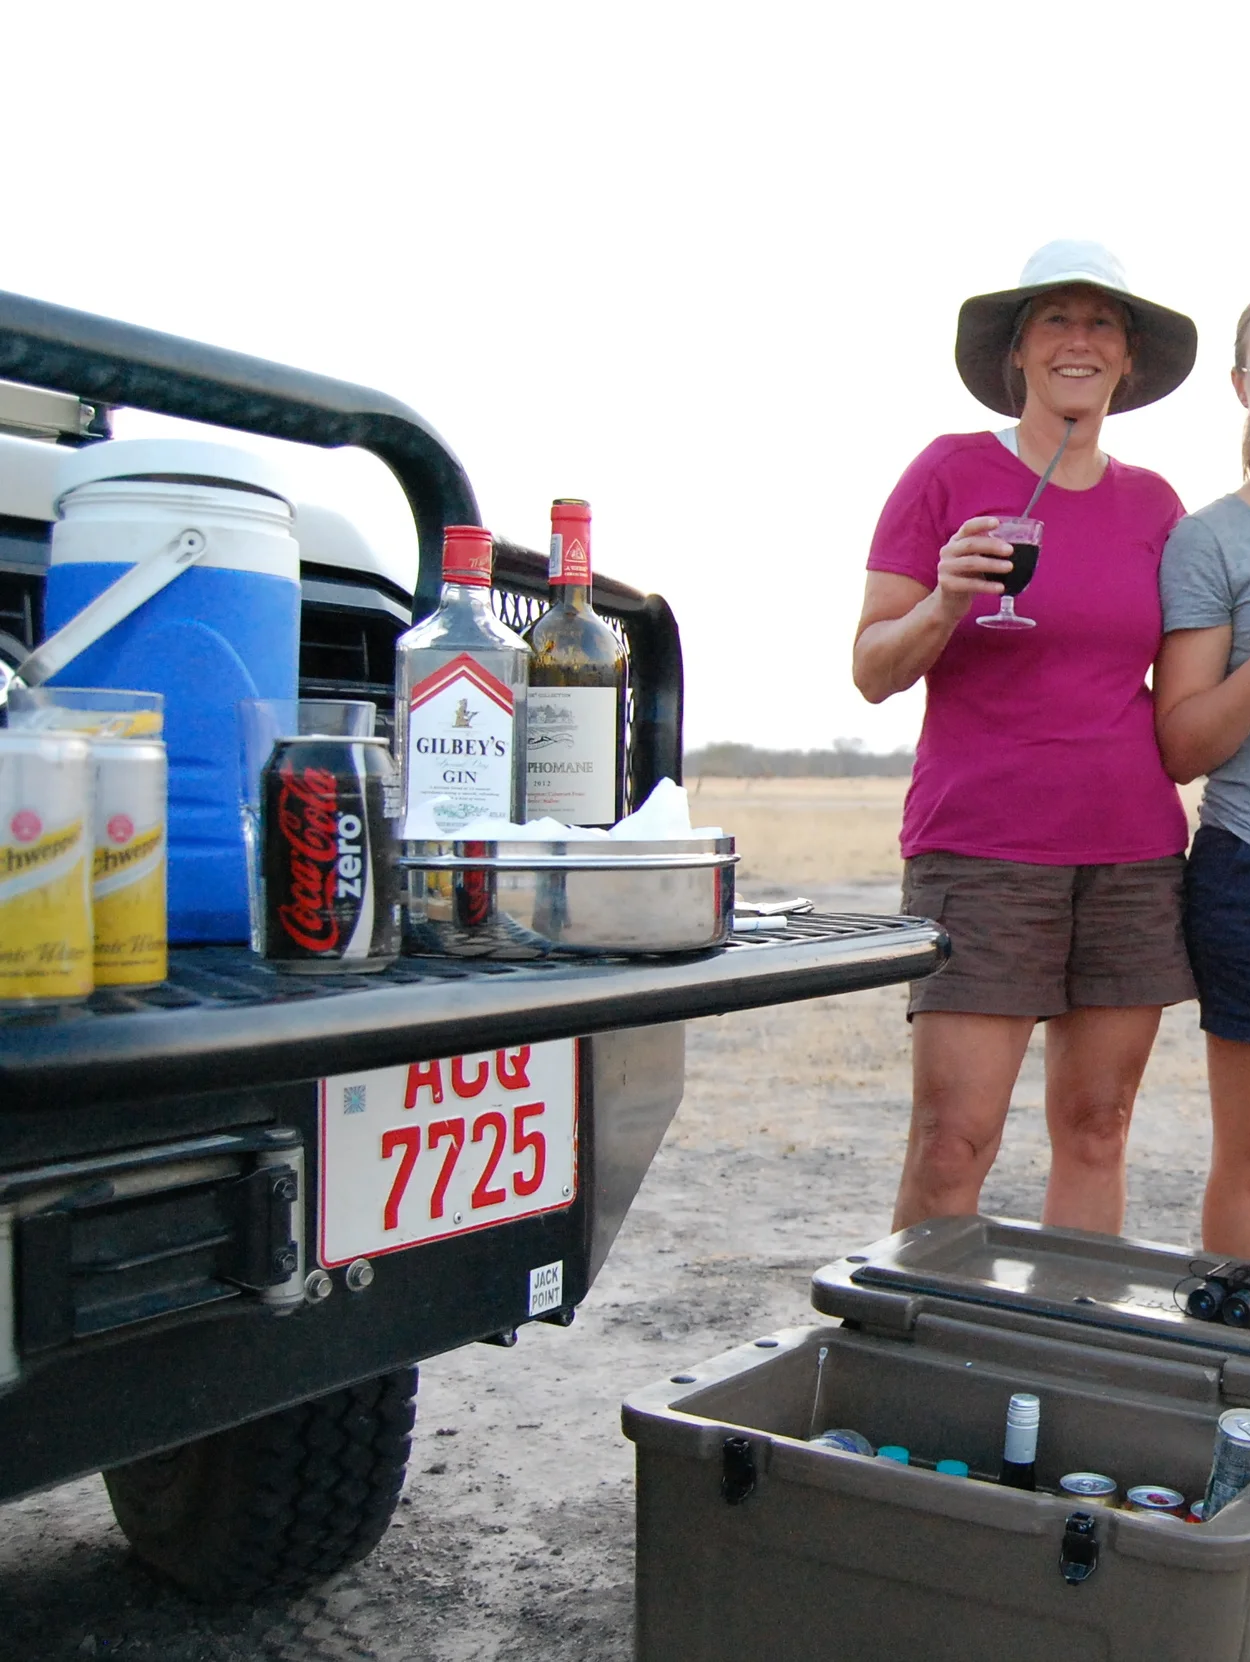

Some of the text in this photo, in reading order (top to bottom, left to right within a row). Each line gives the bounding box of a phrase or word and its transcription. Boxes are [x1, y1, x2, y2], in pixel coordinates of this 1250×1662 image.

[416, 735, 506, 757] GILBEY'S
[442, 769, 478, 784] GIN
[527, 761, 593, 774] PHOMANE
[337, 812, 362, 898] zero
[381, 1101, 546, 1231] 7725
[534, 1266, 559, 1289] JACK
[532, 1286, 561, 1311] POINT
